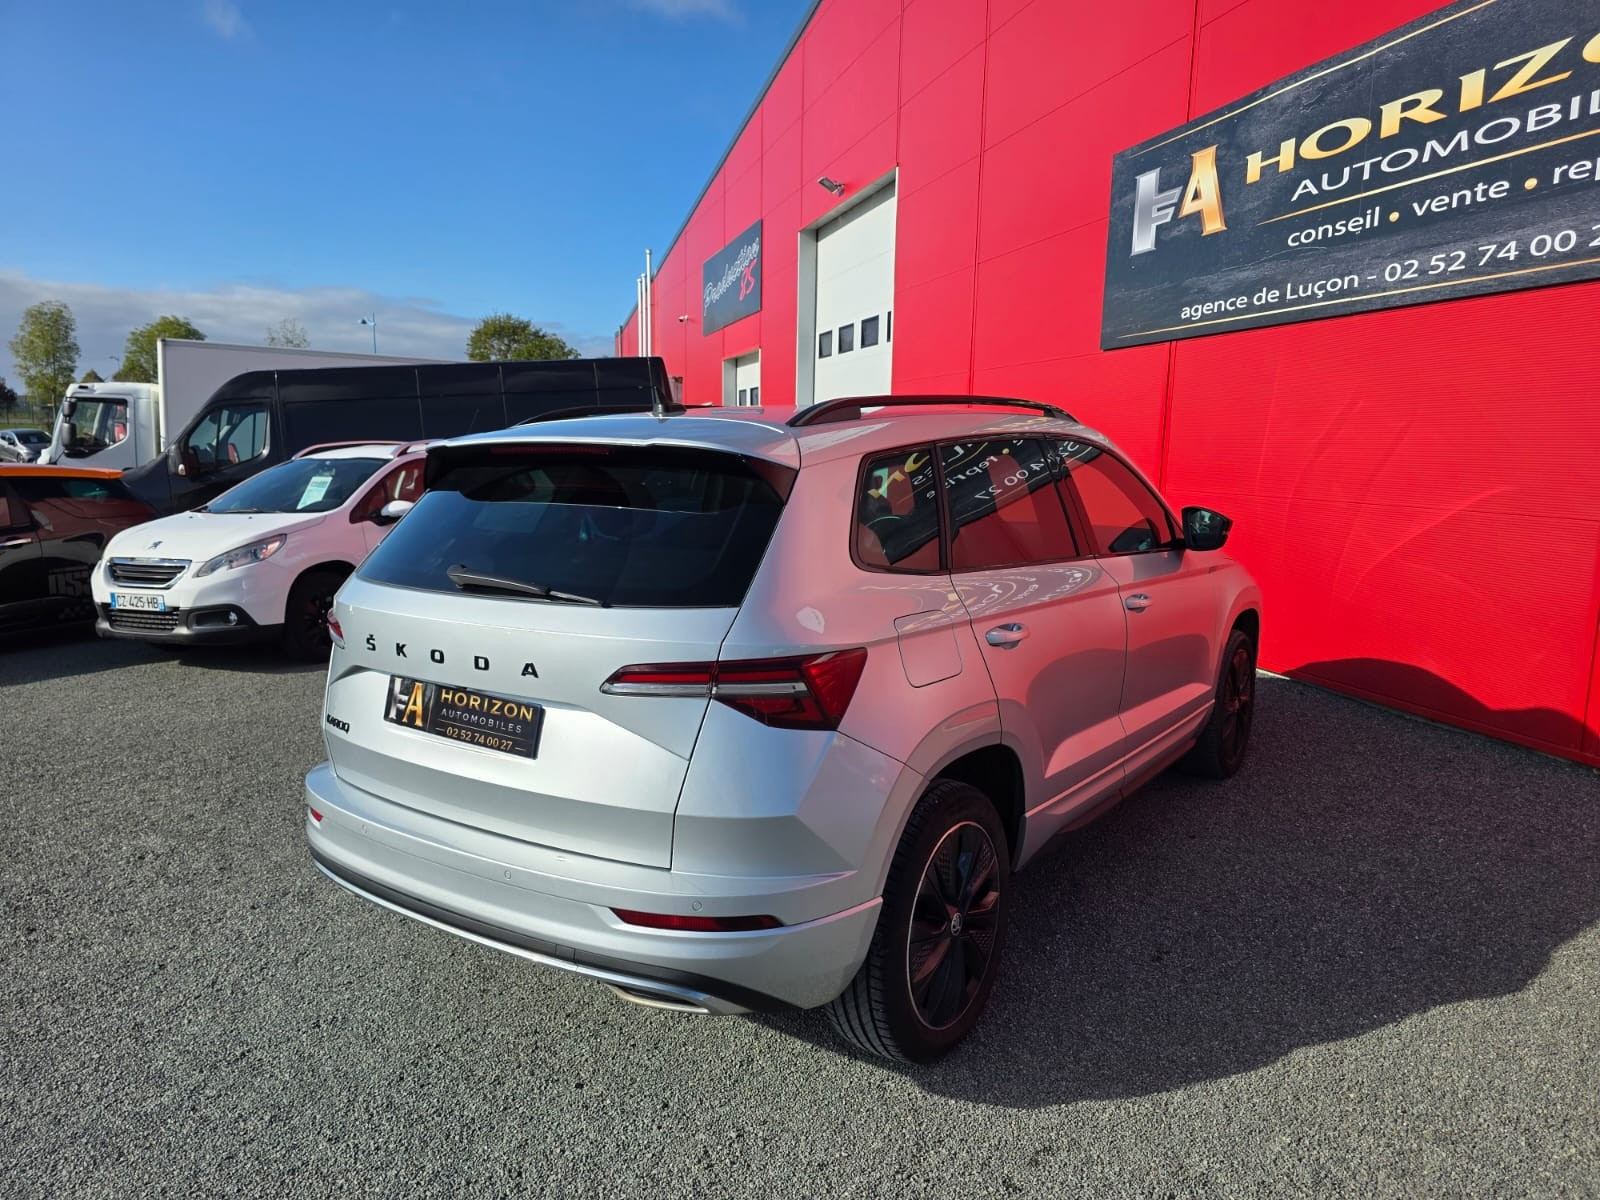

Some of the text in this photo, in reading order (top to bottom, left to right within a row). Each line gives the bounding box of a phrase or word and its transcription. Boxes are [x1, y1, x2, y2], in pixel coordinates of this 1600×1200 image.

[1287, 206, 1380, 247] conseil
[1412, 180, 1510, 217] vente
[1181, 295, 1248, 320] agence
[1253, 287, 1279, 306] de
[1286, 271, 1359, 301] Luçon
[1384, 259, 1419, 283] 02
[1428, 250, 1466, 275] 52
[1478, 240, 1519, 267] 74
[1530, 229, 1577, 257] 00
[366, 633, 539, 678] ŠKODA
[440, 688, 534, 723] HORIZON
[441, 708, 522, 733] AUTOMOBILES
[446, 726, 513, 751] 02 52 74 00 27
